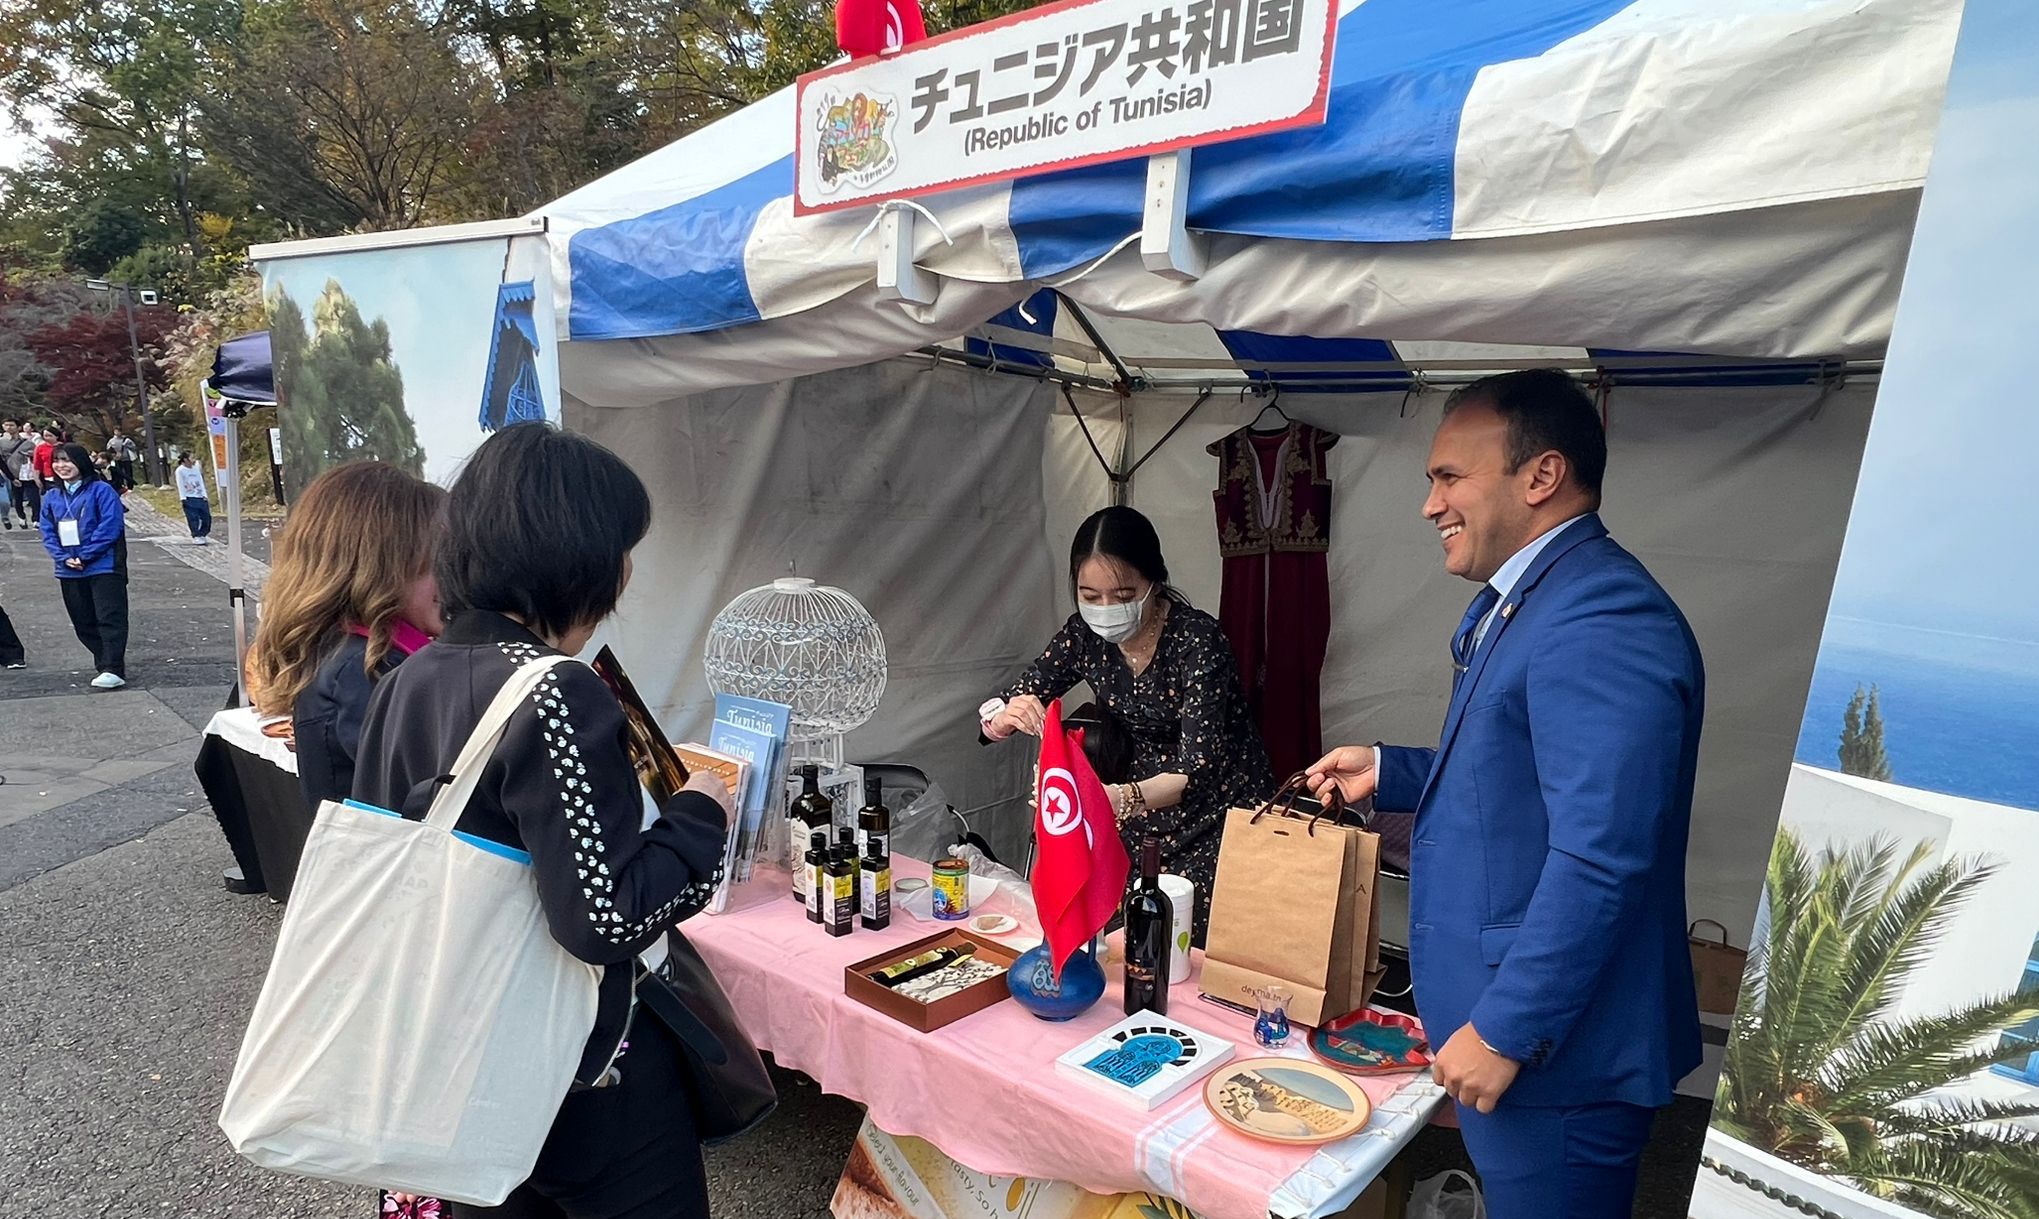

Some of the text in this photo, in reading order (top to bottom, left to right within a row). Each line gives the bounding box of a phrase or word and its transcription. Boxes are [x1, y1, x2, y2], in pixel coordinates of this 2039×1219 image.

[911, 0, 1302, 134] チュニジア共和国
[963, 79, 1211, 156] (Republic of Tunisia)
[727, 709, 773, 735] Tunisia
[719, 737, 755, 762] Tunisia
[883, 1155, 897, 1173] your
[896, 1169, 919, 1206] flavour
